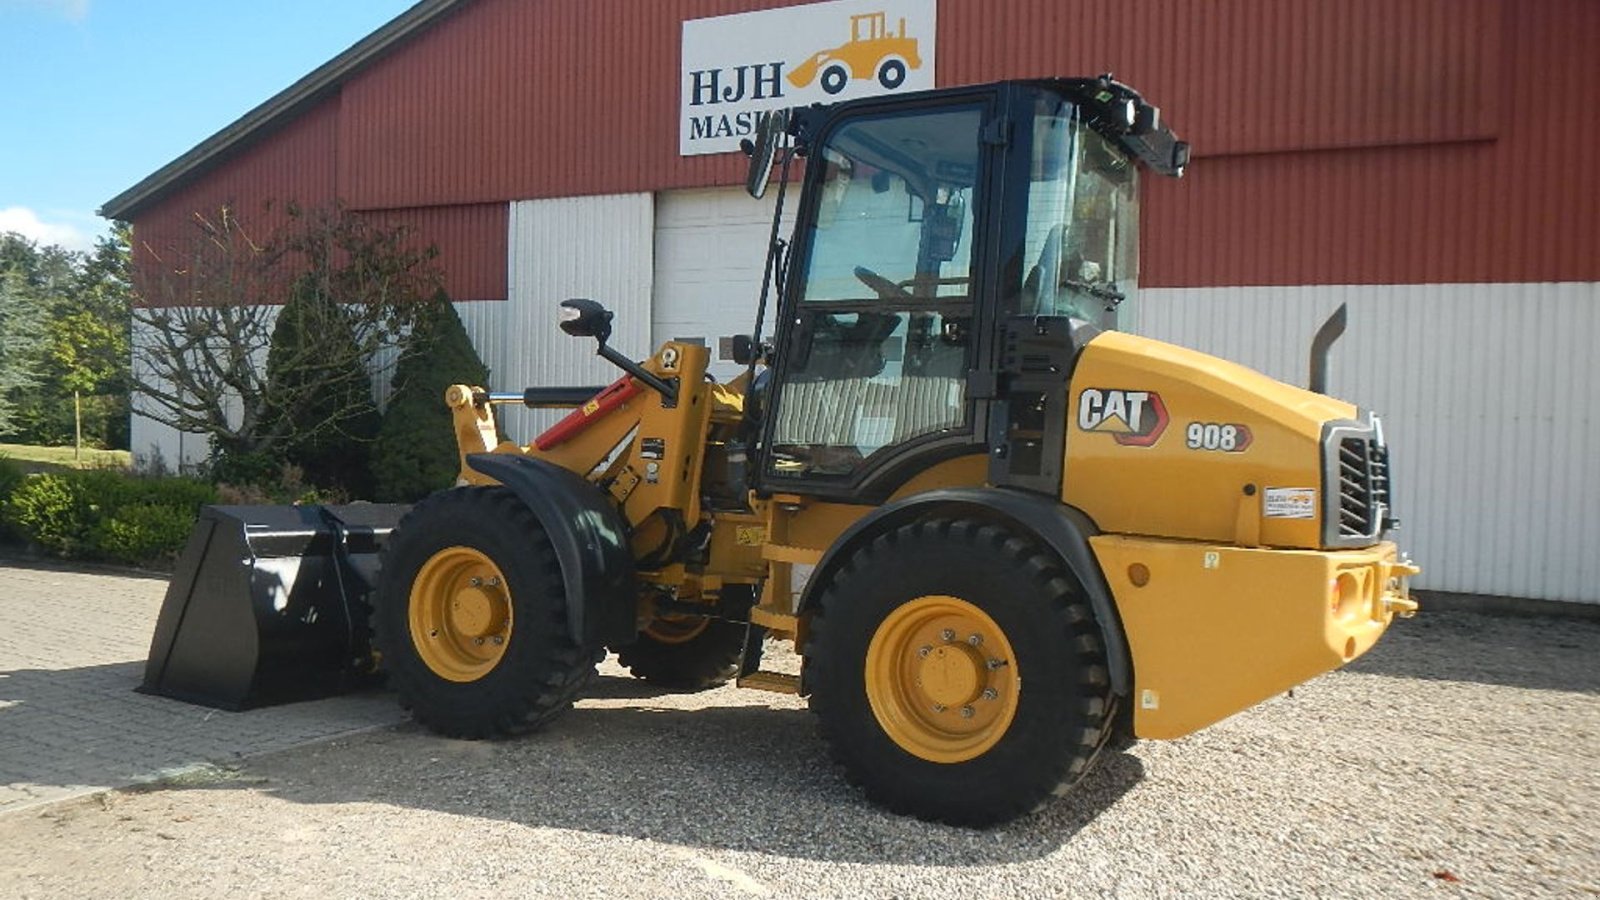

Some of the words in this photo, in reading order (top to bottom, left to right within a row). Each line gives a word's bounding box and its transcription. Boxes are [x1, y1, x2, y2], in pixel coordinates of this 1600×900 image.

[689, 62, 785, 106] HJH
[1080, 389, 1148, 433] CAT
[1187, 423, 1237, 450] 908
